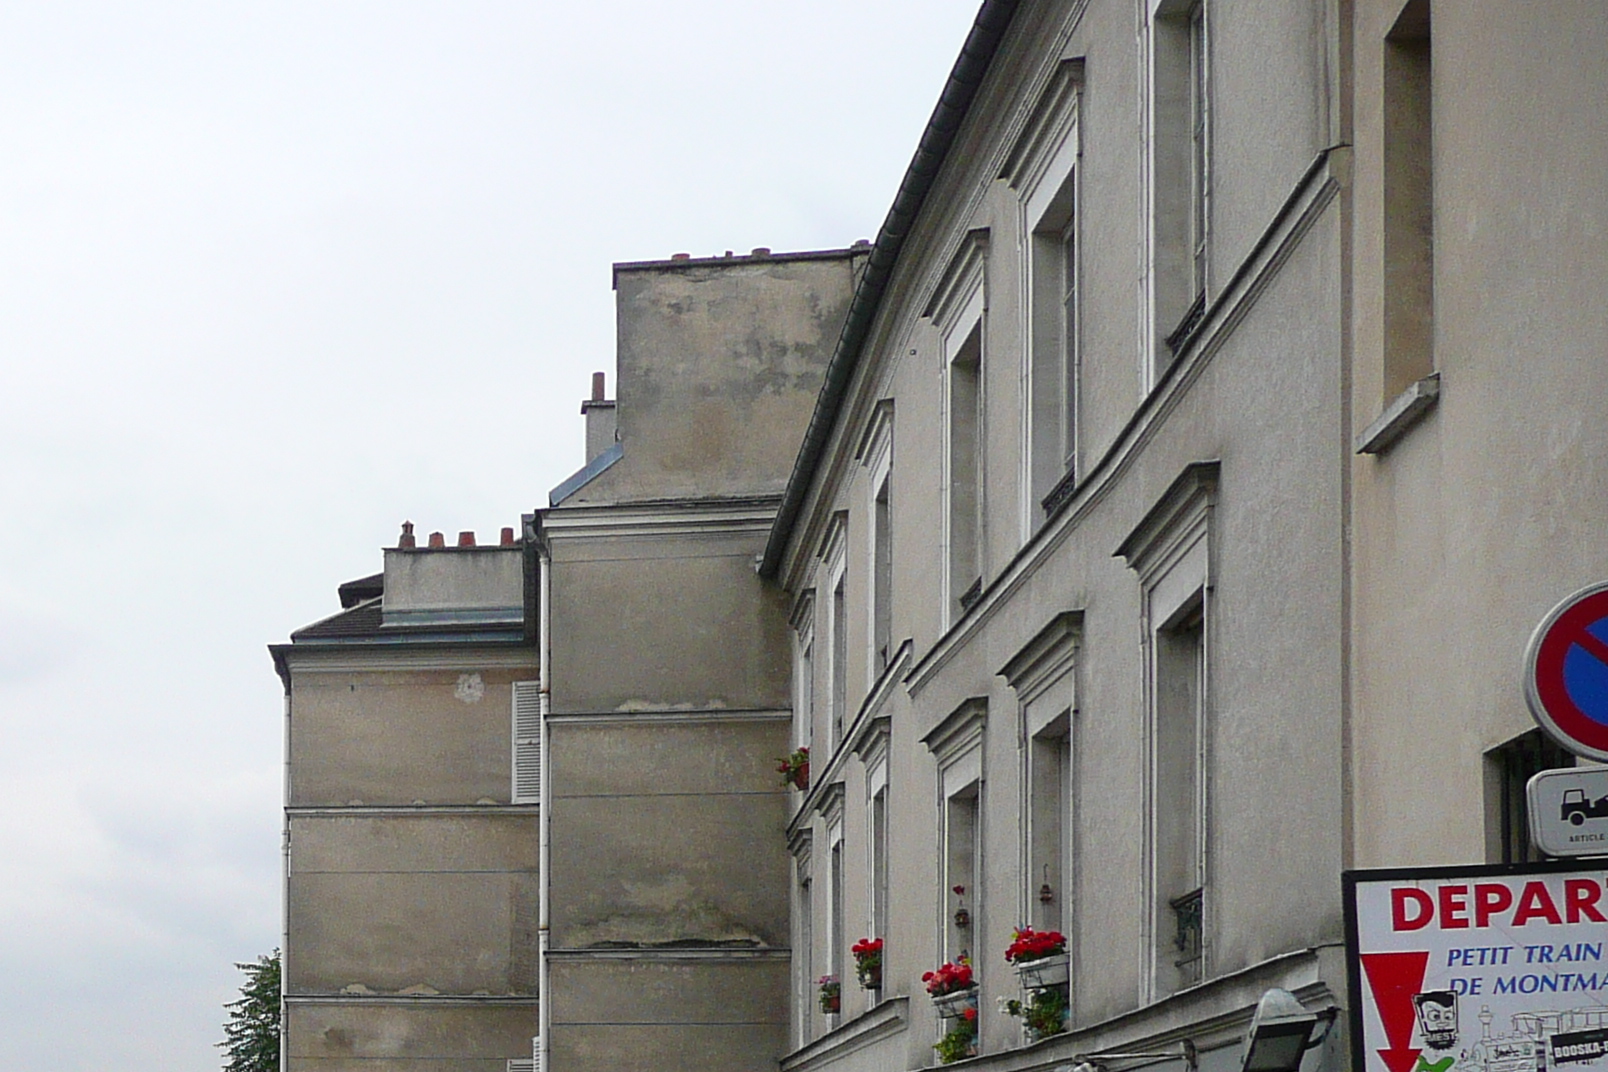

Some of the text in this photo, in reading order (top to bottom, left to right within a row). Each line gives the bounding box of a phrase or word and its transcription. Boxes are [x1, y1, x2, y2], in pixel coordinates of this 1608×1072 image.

[1569, 833, 1606, 843] ARTICLE
[1390, 877, 1608, 932] DEPAR
[1447, 942, 1603, 967] PETIT TRAIN
[1450, 977, 1483, 996] DE
